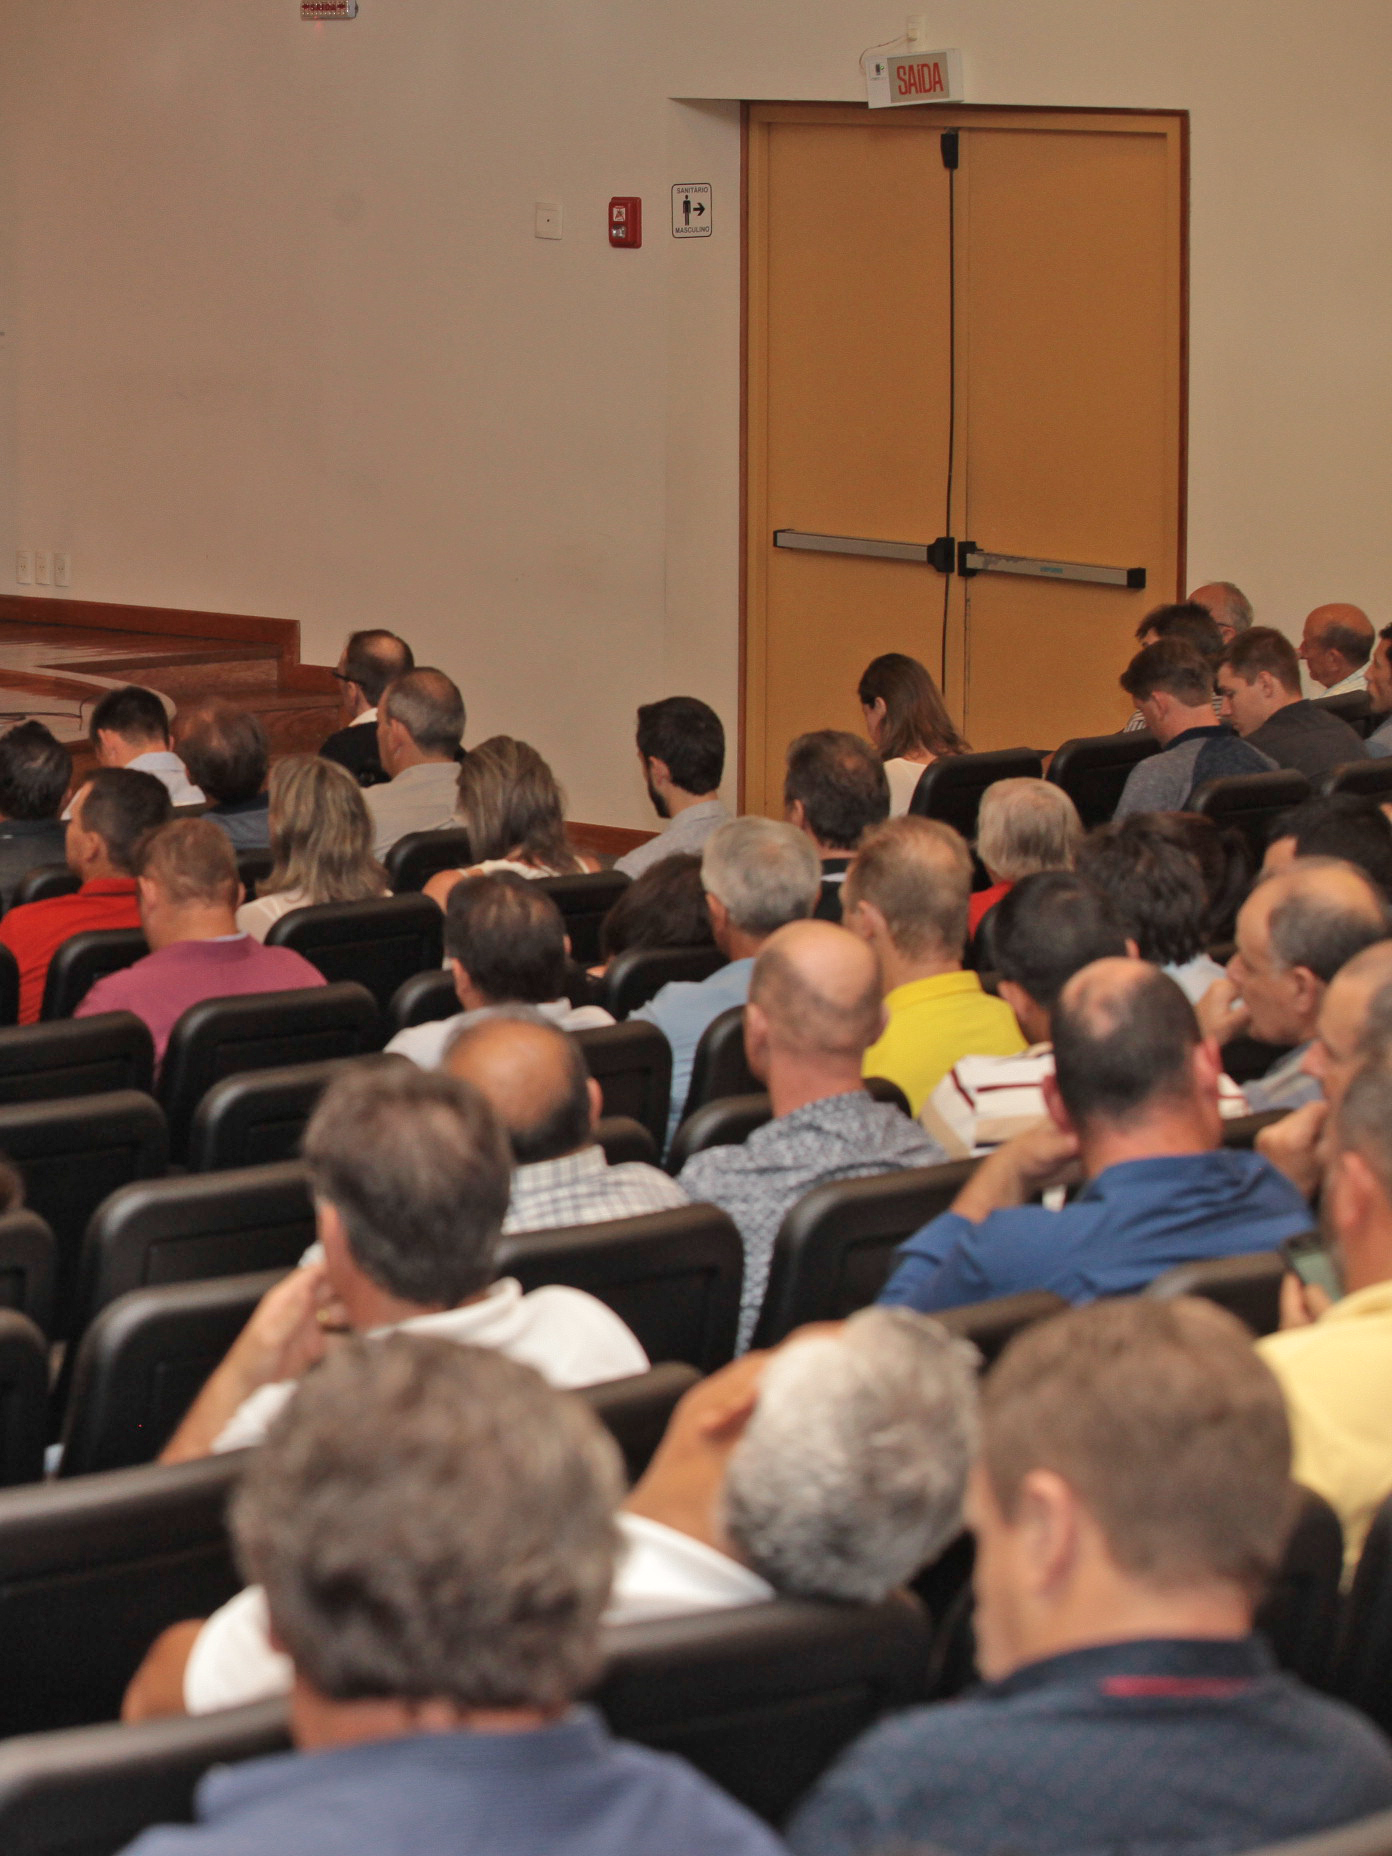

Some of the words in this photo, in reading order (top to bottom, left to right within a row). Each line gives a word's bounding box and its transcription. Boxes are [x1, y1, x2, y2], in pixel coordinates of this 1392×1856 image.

[896, 62, 945, 95] SAÍDA
[676, 186, 709, 194] SANITÁRIO
[675, 226, 710, 234] MASCULINO
